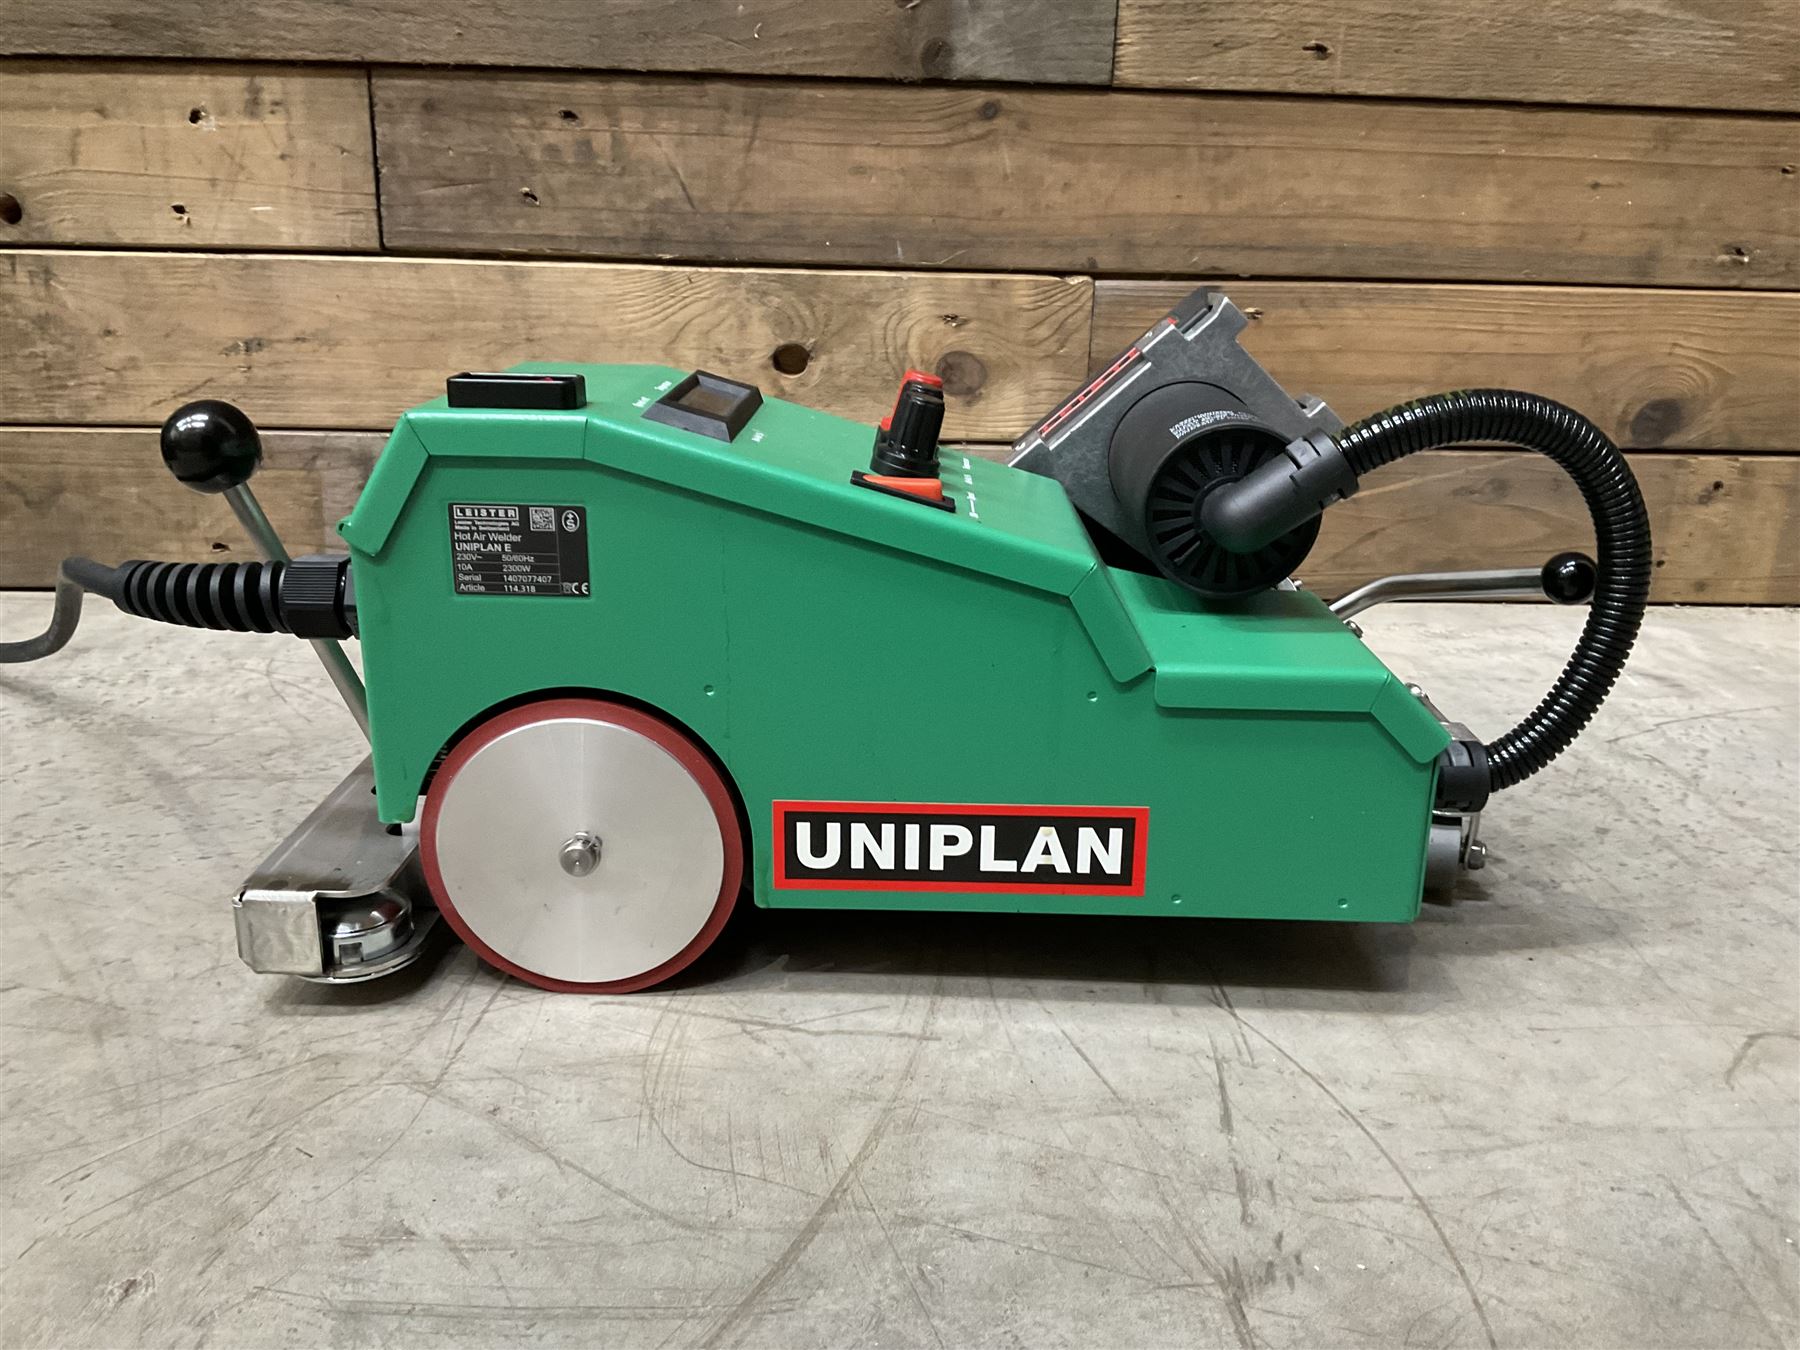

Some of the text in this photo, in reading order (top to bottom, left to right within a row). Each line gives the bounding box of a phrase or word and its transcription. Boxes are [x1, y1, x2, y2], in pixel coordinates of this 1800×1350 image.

[456, 507, 517, 518] LEISTER
[454, 532, 522, 542] Hot Air Welder
[455, 542, 512, 552] UNIPLAN E
[501, 554, 535, 563] 50/60Hz
[457, 563, 531, 573] 10A 2300W
[458, 573, 552, 583] Serial 1407077407
[459, 583, 536, 593] Article 114.318
[795, 821, 1124, 875] UNIPLAN
